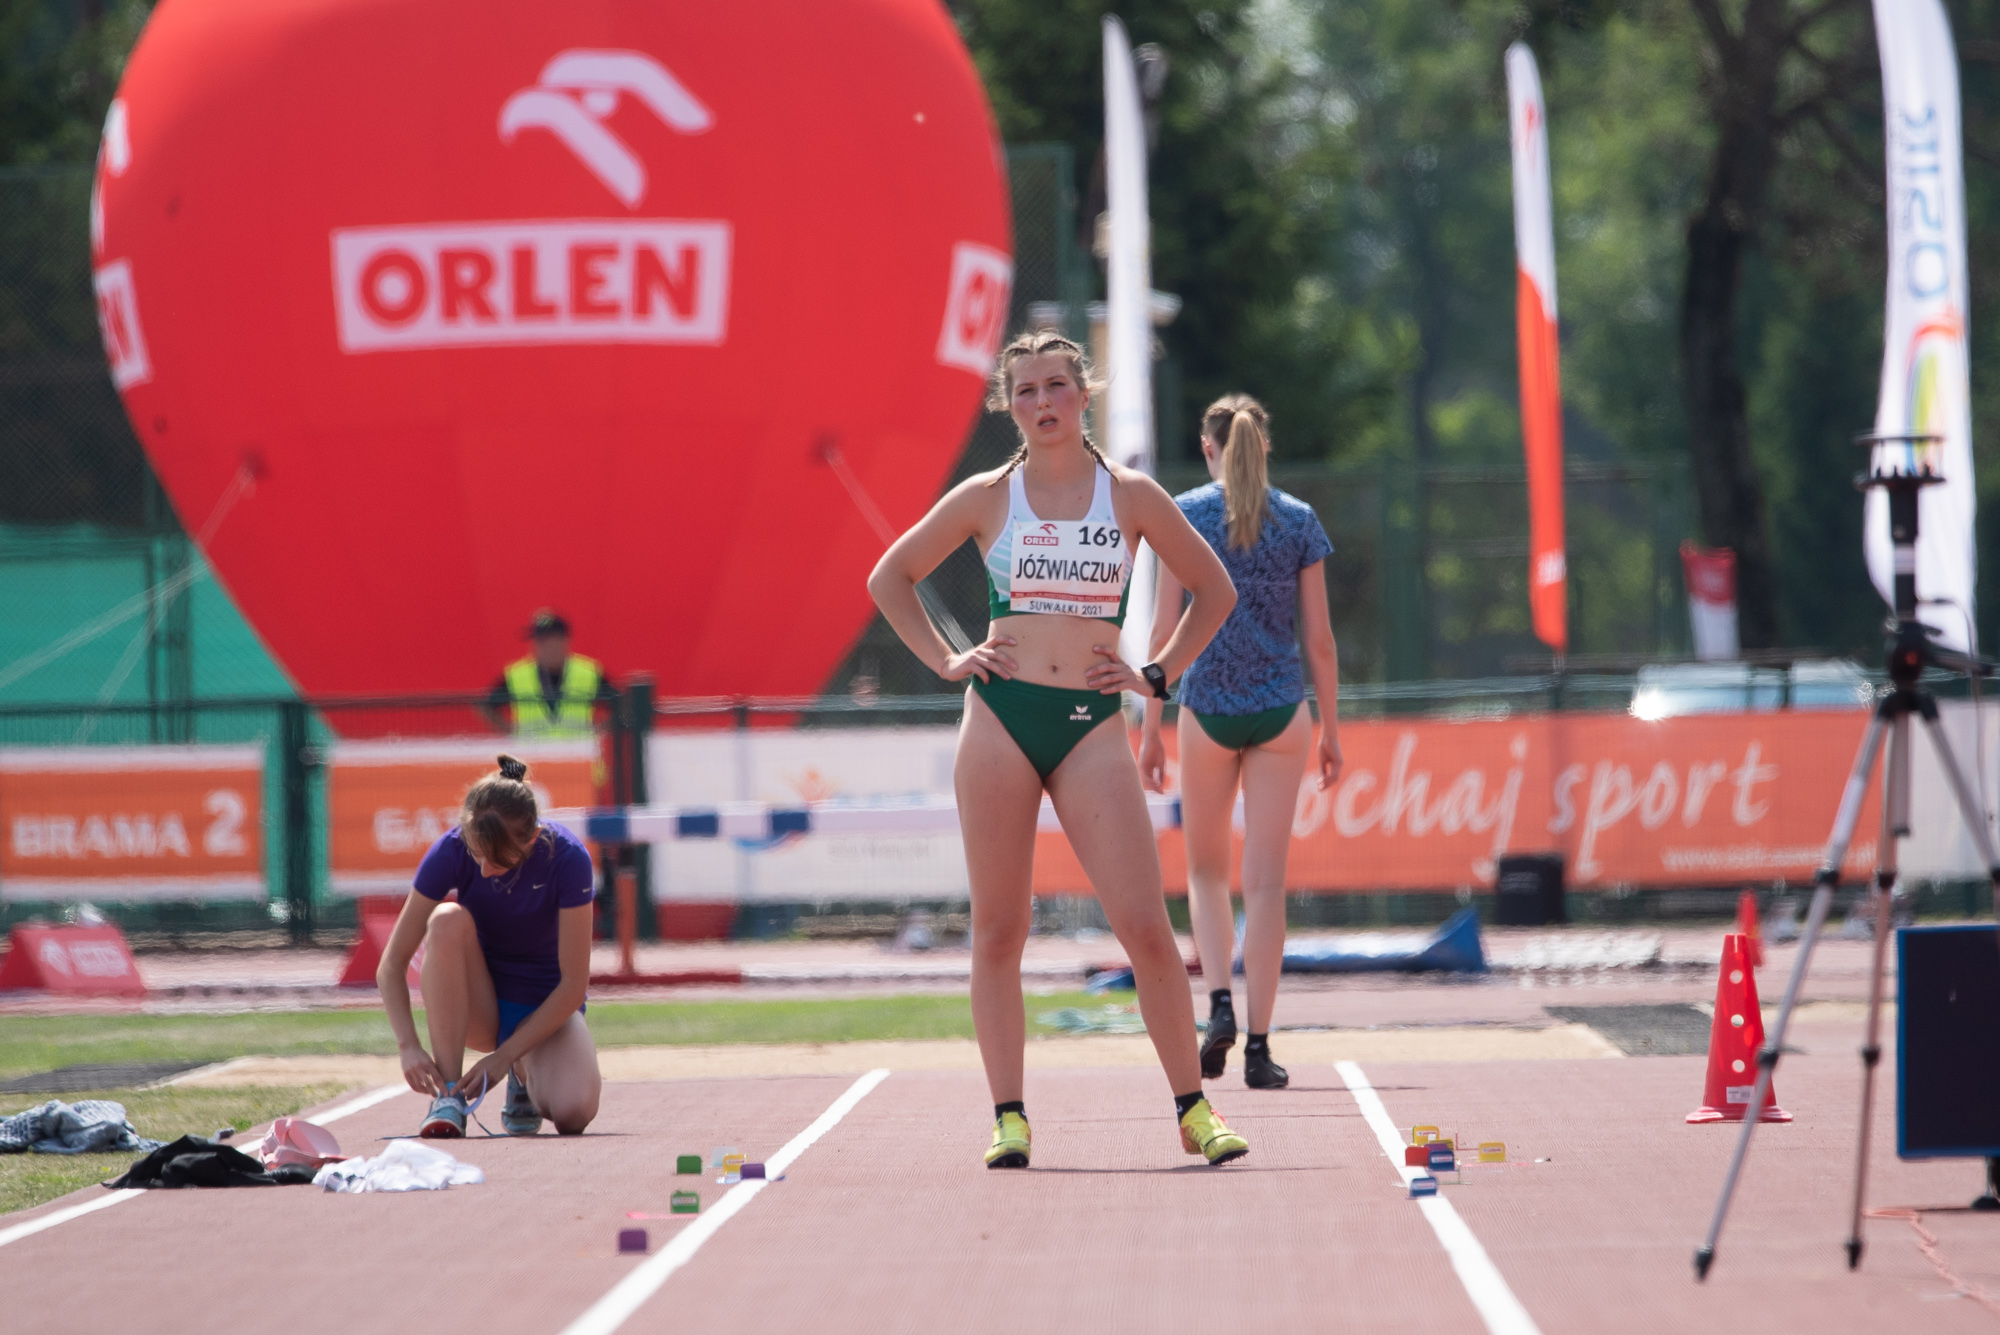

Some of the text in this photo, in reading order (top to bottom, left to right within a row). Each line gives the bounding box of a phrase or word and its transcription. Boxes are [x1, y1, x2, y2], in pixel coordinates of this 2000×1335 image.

[358, 243, 700, 329] ORLEN
[1024, 537, 1058, 545] ORLEN
[1078, 526, 1121, 548] 169
[1015, 555, 1122, 583] JÓŹWIACZUK
[1029, 600, 1102, 615] SUWAŁKI 2021
[1291, 730, 1779, 882] ochaj sport
[11, 788, 247, 859] BRAMA 2
